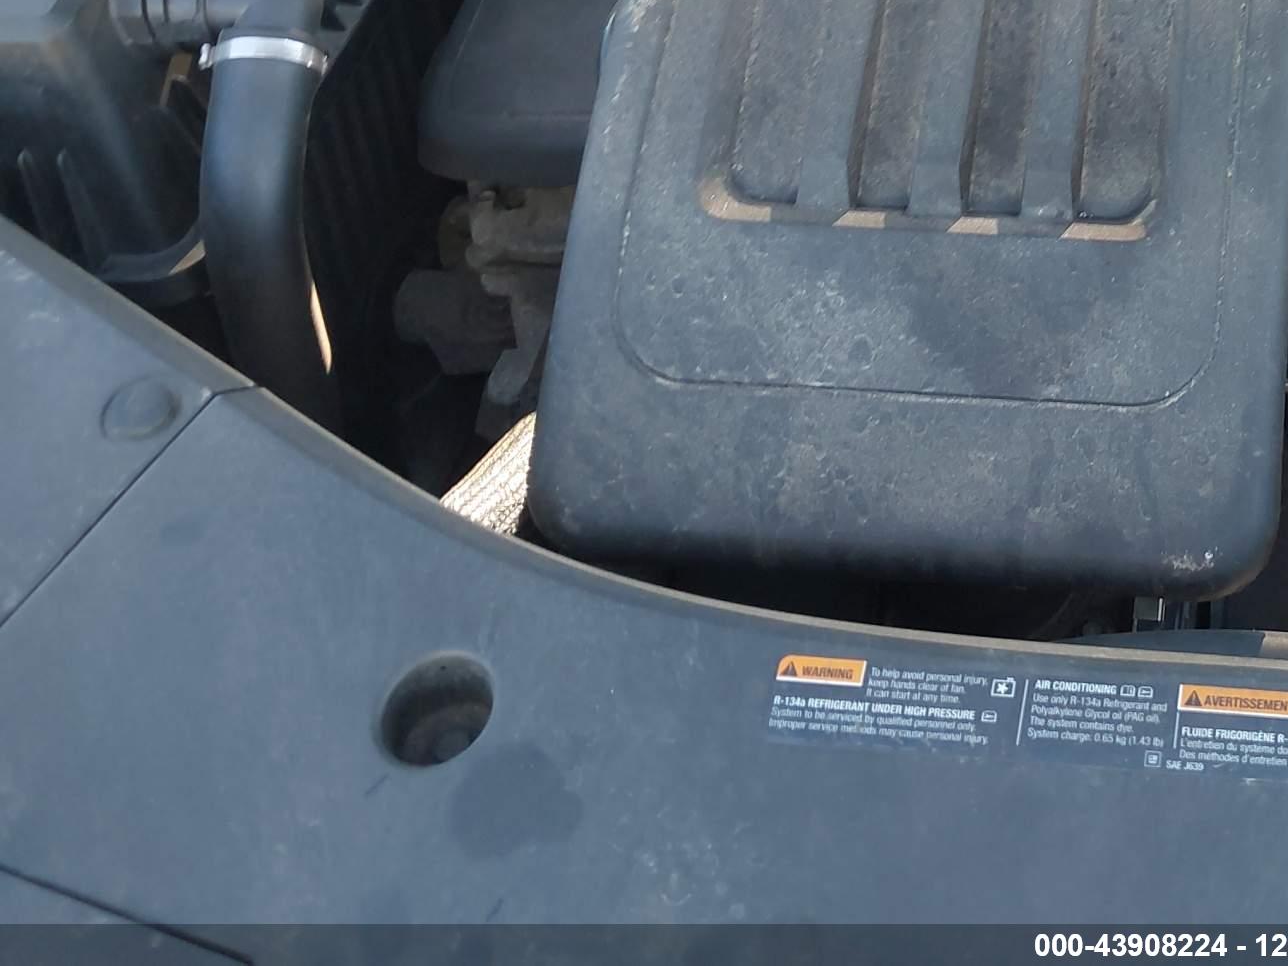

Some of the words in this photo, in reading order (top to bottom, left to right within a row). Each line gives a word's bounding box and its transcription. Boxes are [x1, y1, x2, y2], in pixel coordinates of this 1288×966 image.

[802, 666, 853, 680] WARNING
[872, 667, 880, 676] To
[882, 668, 900, 680] help
[902, 671, 925, 680] avoid
[926, 673, 962, 683] personal
[868, 678, 888, 689] keep
[890, 680, 915, 690] hands
[918, 682, 938, 692] clear
[940, 683, 950, 692] of
[1035, 680, 1050, 690] AIR
[1052, 681, 1116, 694] CONDITIONING
[866, 688, 872, 696] It
[874, 690, 889, 698] can
[892, 690, 910, 700] start
[912, 692, 920, 701] at
[922, 694, 938, 703] any
[940, 694, 960, 704] time.
[1032, 692, 1049, 702] Use
[1051, 694, 1068, 706] only
[1070, 695, 1101, 707] R-134a
[1103, 698, 1150, 712] Refrigerant
[1151, 702, 1168, 712] and
[774, 695, 806, 707] R-134a
[808, 698, 870, 712] REFRIGERANT
[872, 703, 902, 715] UNDER
[904, 705, 927, 716] HIGH
[928, 707, 976, 720] PRESSURE
[1084, 708, 1110, 720] Glycol
[1112, 710, 1122, 720] oil
[1124, 711, 1144, 722] (PAG
[771, 706, 802, 718] System
[804, 710, 812, 719] to
[814, 710, 826, 720] be
[828, 713, 862, 722] serviced
[864, 715, 874, 724] by
[876, 716, 912, 726] qualified
[914, 720, 956, 729] personnel
[957, 722, 976, 732] only.
[1030, 716, 1046, 726] The
[1047, 718, 1078, 728] system
[1080, 720, 1114, 731] contains
[768, 718, 806, 730] Improper
[808, 722, 838, 732] service
[878, 728, 896, 738] may
[899, 729, 924, 738] cause
[926, 731, 962, 742] personal
[964, 734, 988, 746] injury.
[1028, 727, 1058, 740] System
[1116, 734, 1126, 746] kg
[1152, 736, 1164, 747] lb)
[1181, 726, 1214, 738] FLUIDE
[1215, 728, 1276, 743] FRIGORIGÈNE
[1180, 739, 1224, 751] L'entretien
[1226, 742, 1238, 752] du
[1166, 760, 1182, 770] SAE
[1179, 749, 1196, 760] Des
[1198, 750, 1240, 762] méthodes
[1242, 753, 1287, 766] d'entretien
